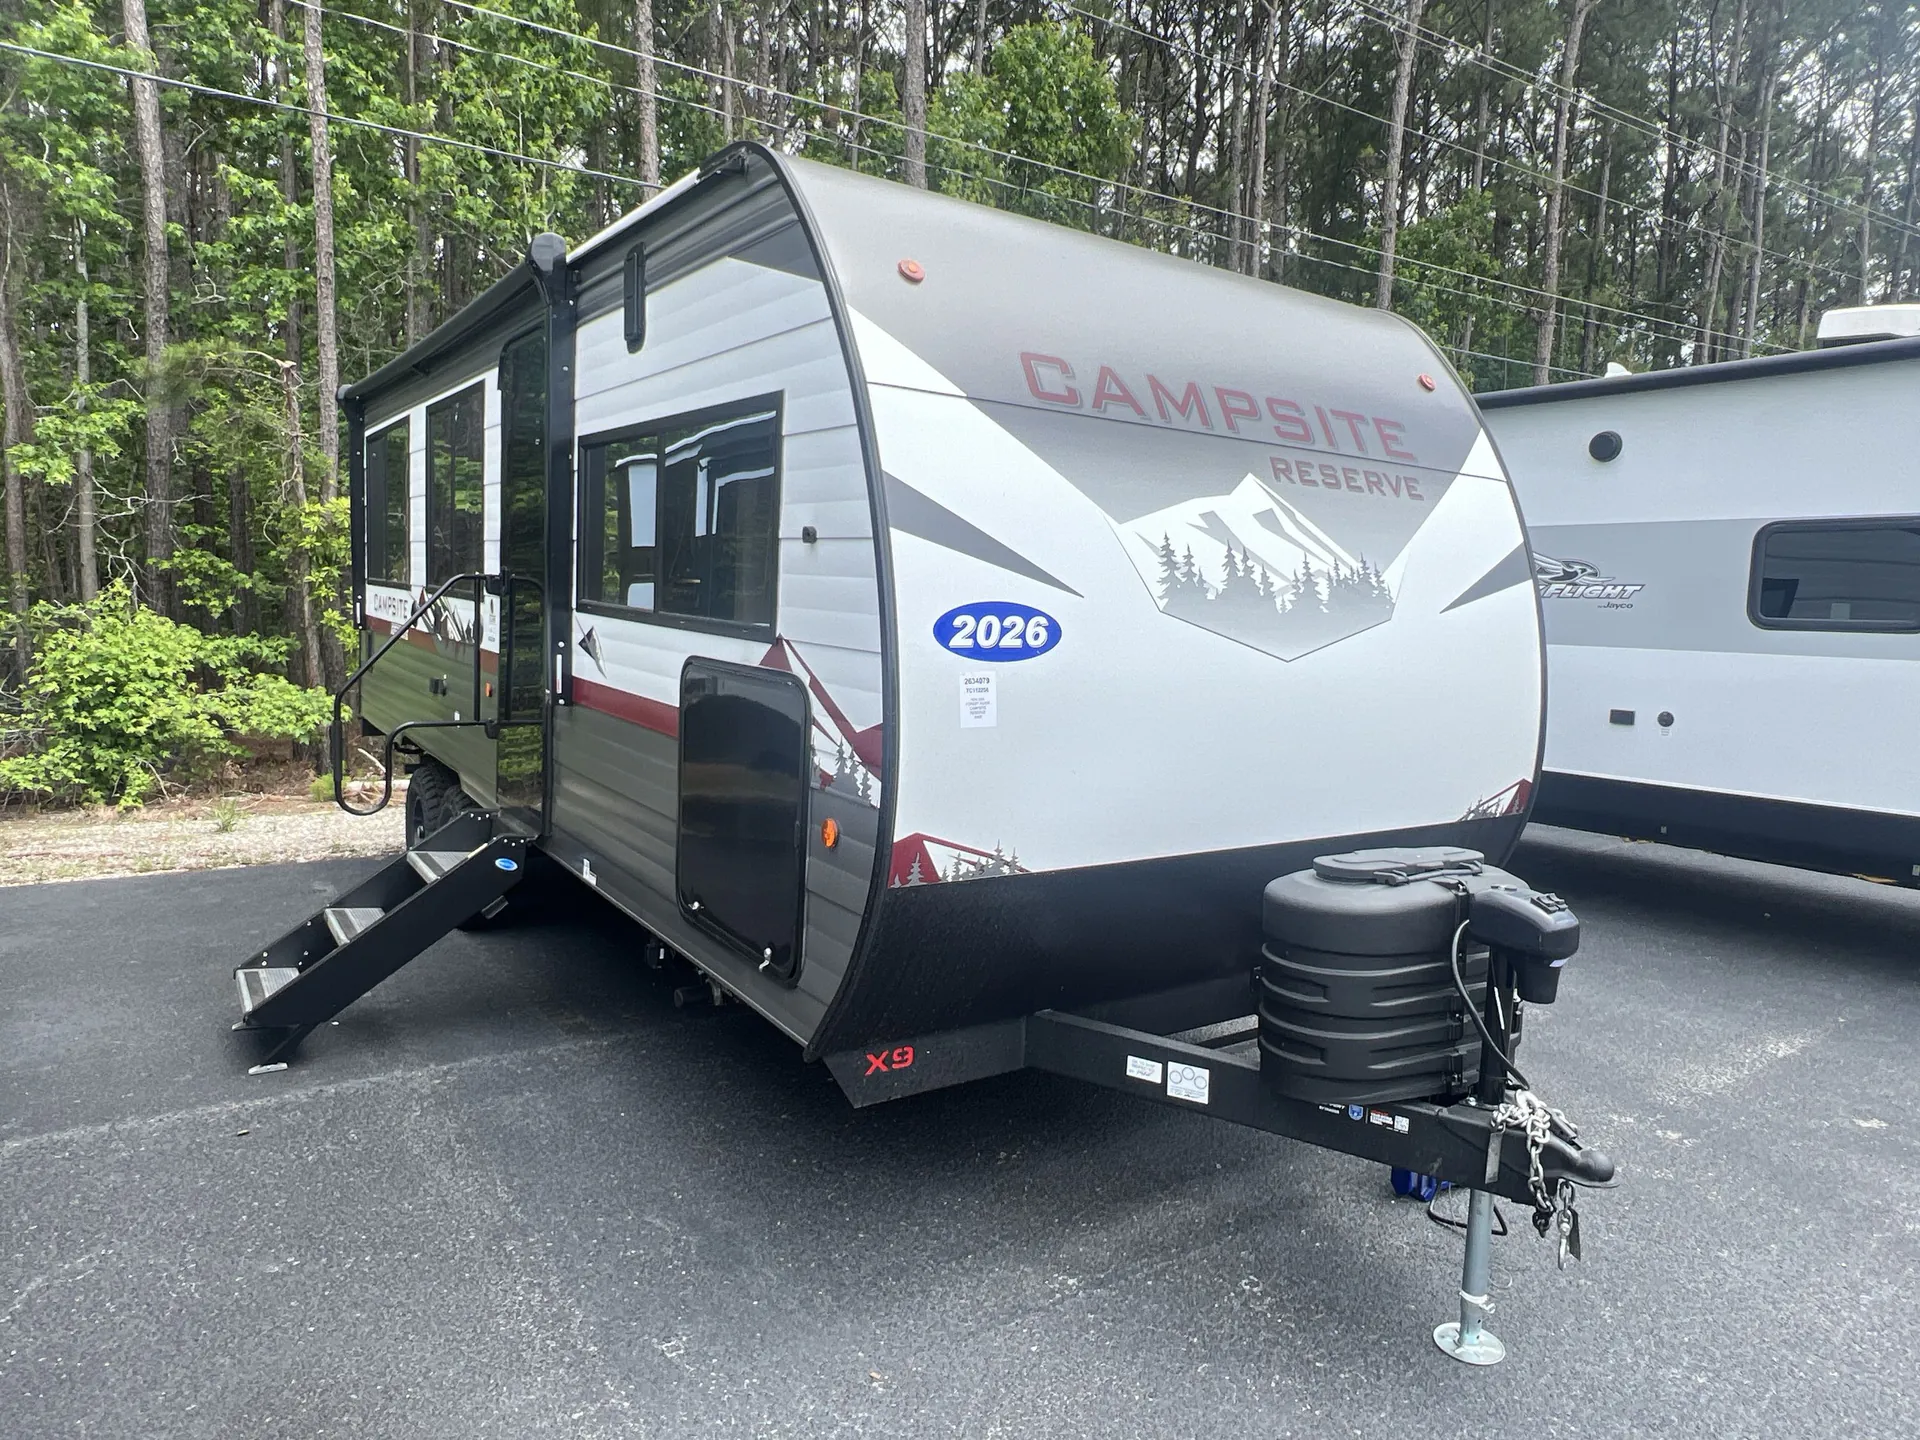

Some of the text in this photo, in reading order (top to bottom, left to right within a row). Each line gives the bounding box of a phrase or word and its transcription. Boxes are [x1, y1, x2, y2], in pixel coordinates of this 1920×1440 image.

[1020, 351, 1418, 462] CAMPSITE
[1269, 456, 1425, 501] RESERVE
[373, 593, 409, 619] CAMPSITE
[1603, 601, 1634, 610] Jayco
[949, 614, 1049, 649] 2026
[864, 1045, 915, 1077] X9
